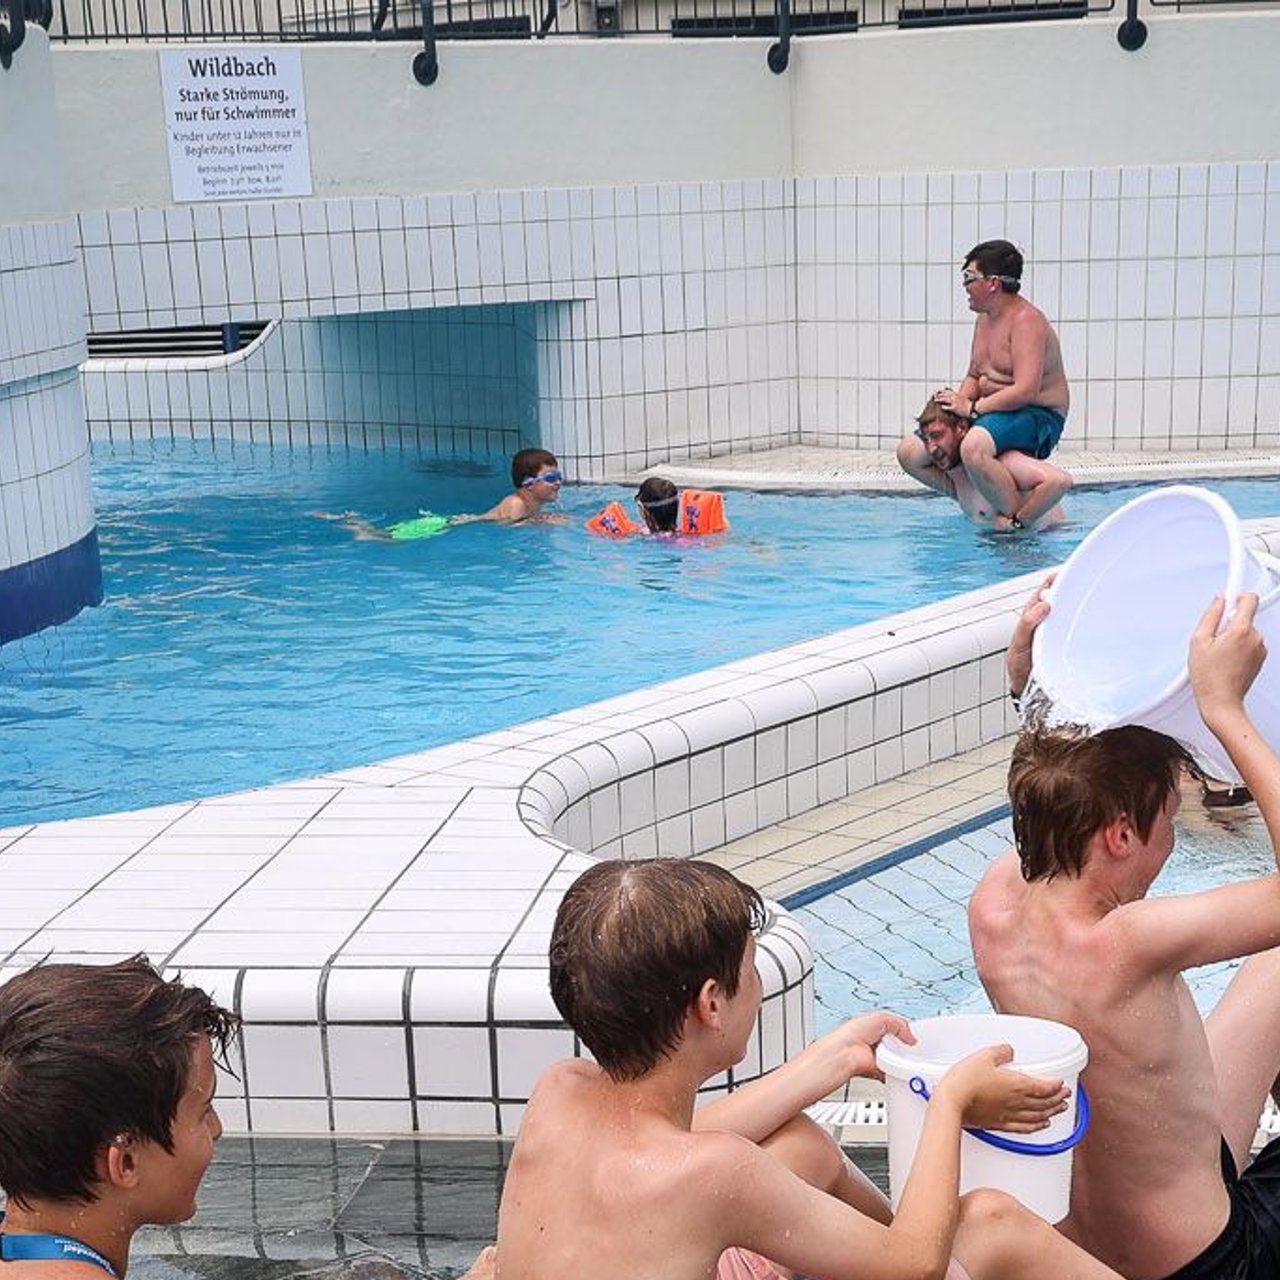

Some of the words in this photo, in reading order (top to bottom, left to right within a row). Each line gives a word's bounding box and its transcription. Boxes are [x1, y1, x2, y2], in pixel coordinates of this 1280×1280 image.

[187, 56, 277, 78] Wildbach
[178, 87, 220, 102] Starke
[224, 86, 289, 104] Strömung,
[175, 110, 198, 122] nur
[201, 107, 220, 121] für
[224, 105, 296, 120] Schwimmer
[173, 131, 204, 142] Kinder
[207, 131, 231, 141] unter
[244, 129, 273, 140] Jahren
[275, 129, 290, 139] nur
[184, 144, 236, 158] Begleitung
[237, 142, 293, 155] Erwachsener
